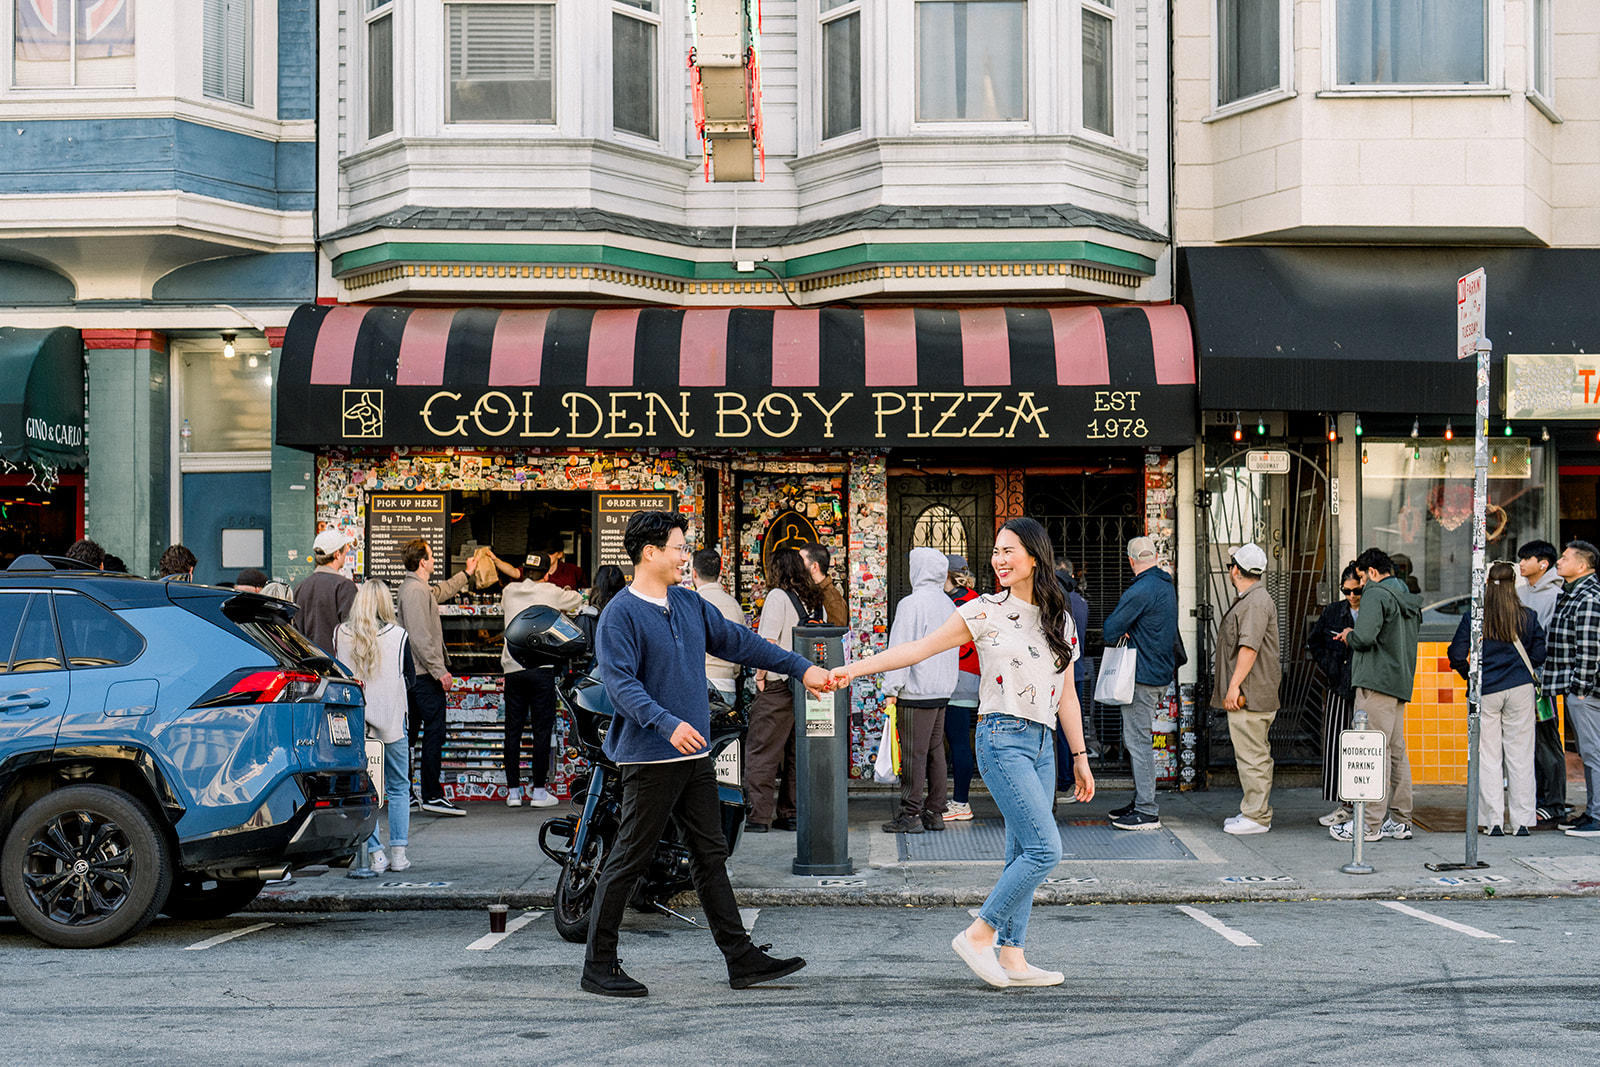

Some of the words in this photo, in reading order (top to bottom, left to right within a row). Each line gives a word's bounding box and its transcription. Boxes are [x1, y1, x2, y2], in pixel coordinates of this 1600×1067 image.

[1462, 321, 1479, 338] TUESDAY
[1093, 391, 1141, 412] EST
[419, 391, 695, 439] GOLDEN
[714, 392, 854, 438] BOY
[872, 391, 1049, 438] PIZZA
[26, 417, 47, 441] GINO
[48, 426, 54, 441] &
[55, 424, 82, 447] CARLO
[1086, 418, 1149, 439] 1978
[376, 499, 397, 507] PICK
[400, 499, 412, 507] UP
[414, 499, 438, 507] HERE
[606, 499, 637, 507] ORDER
[640, 499, 664, 507] HERE
[228, 516, 256, 527] 546
[381, 515, 393, 524] By
[395, 515, 412, 523] The
[415, 515, 433, 523] Pan
[606, 515, 618, 524] By
[621, 515, 631, 523] Th
[1343, 747, 1382, 756] MOTORCYCLE
[1348, 761, 1375, 770] PARKING
[1354, 776, 1370, 784] ONLY
